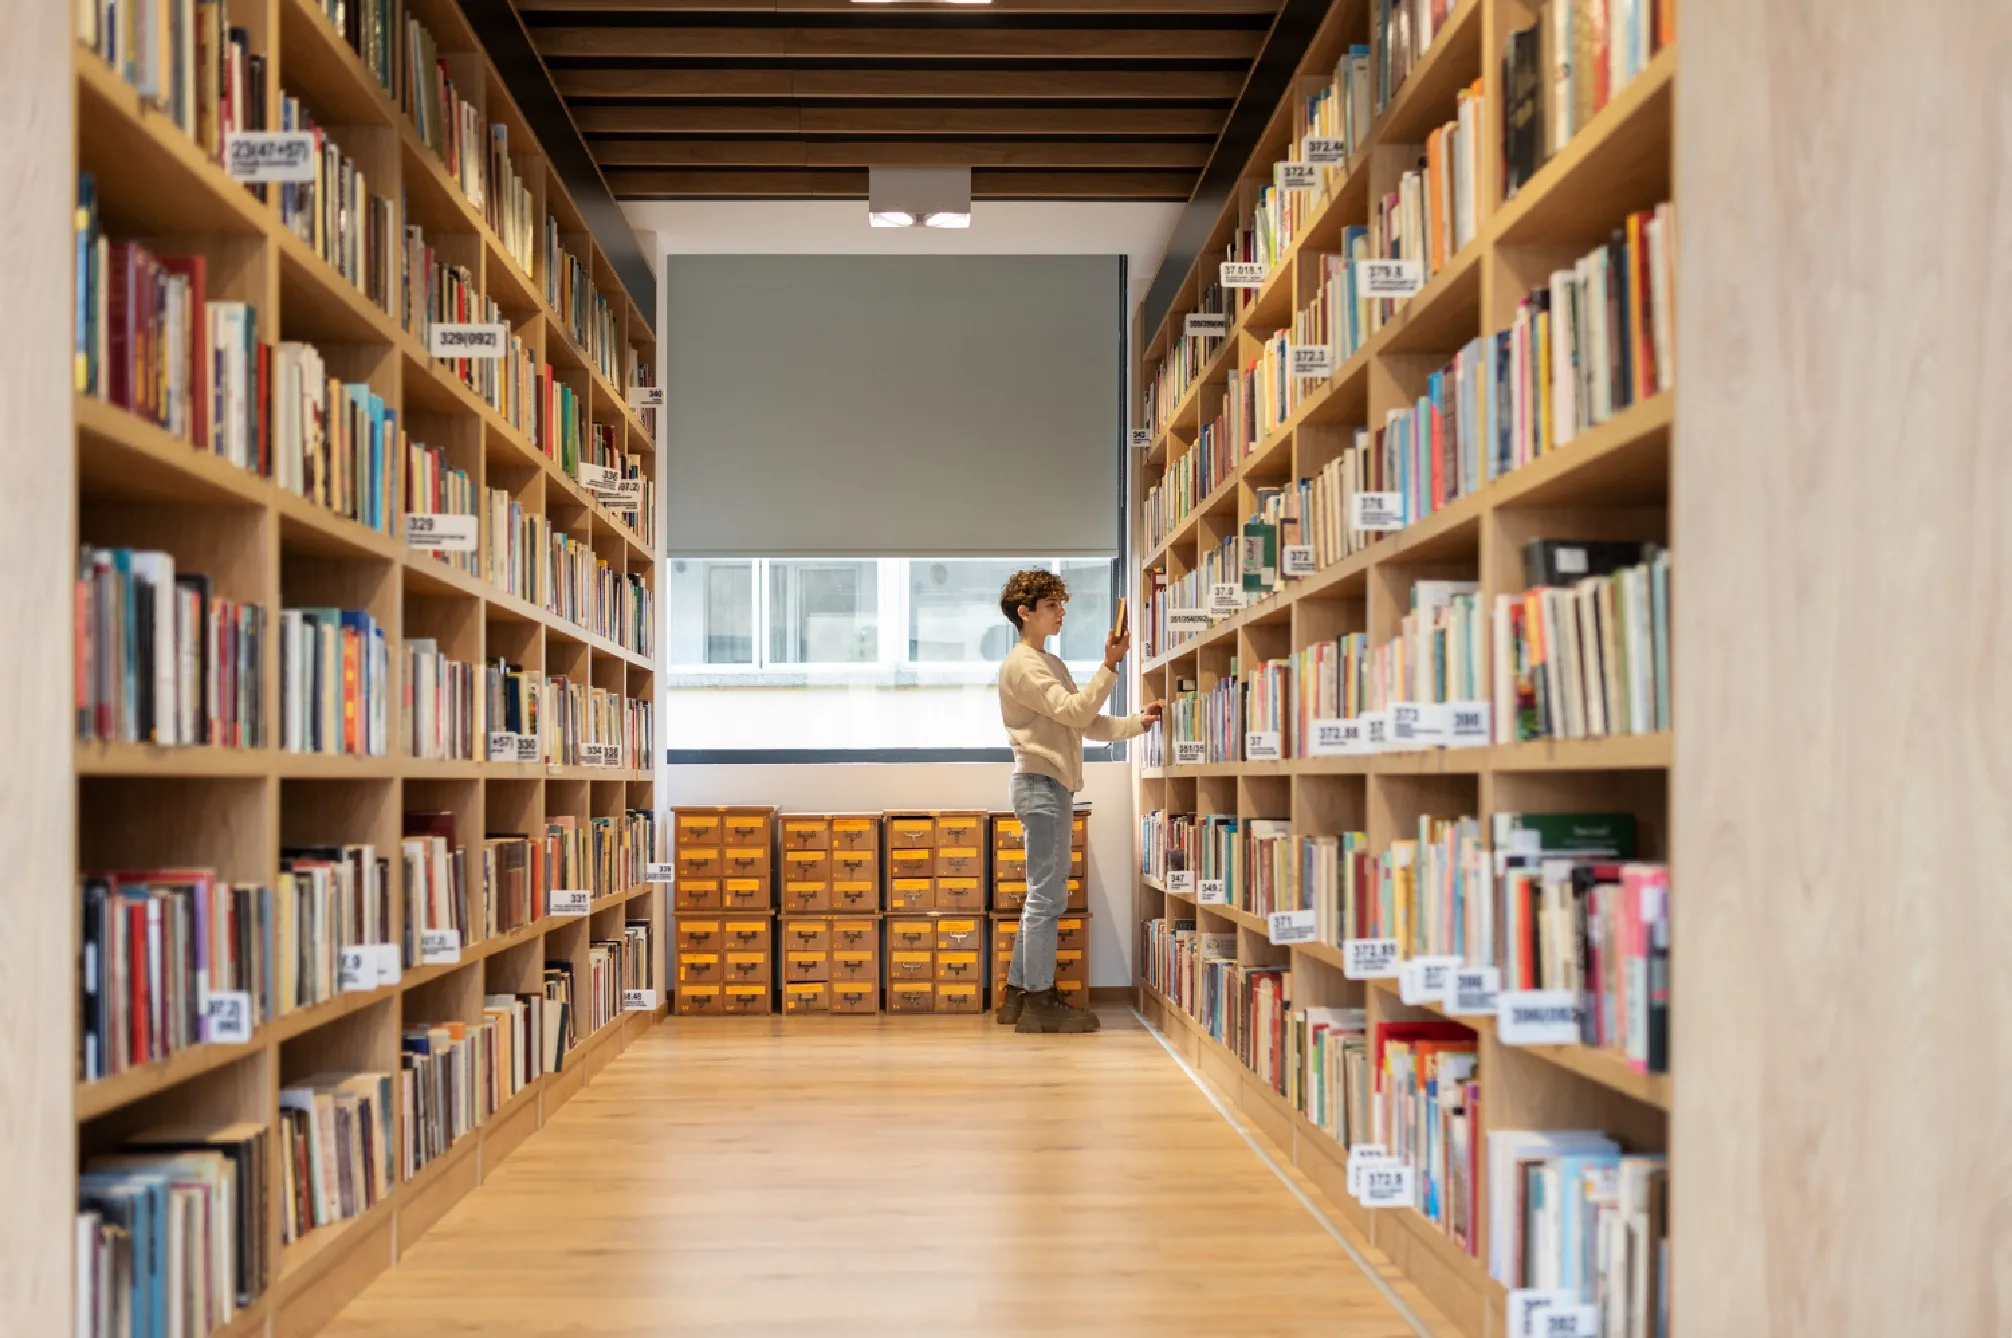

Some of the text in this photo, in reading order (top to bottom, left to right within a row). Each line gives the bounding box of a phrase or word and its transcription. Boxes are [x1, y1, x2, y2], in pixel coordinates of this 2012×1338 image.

[439, 332, 496, 347] 329(092)
[409, 518, 434, 530] 329
[1291, 551, 1309, 561] 372
[1250, 736, 1262, 746] 37
[1171, 875, 1185, 883] 347
[570, 895, 586, 903] 331
